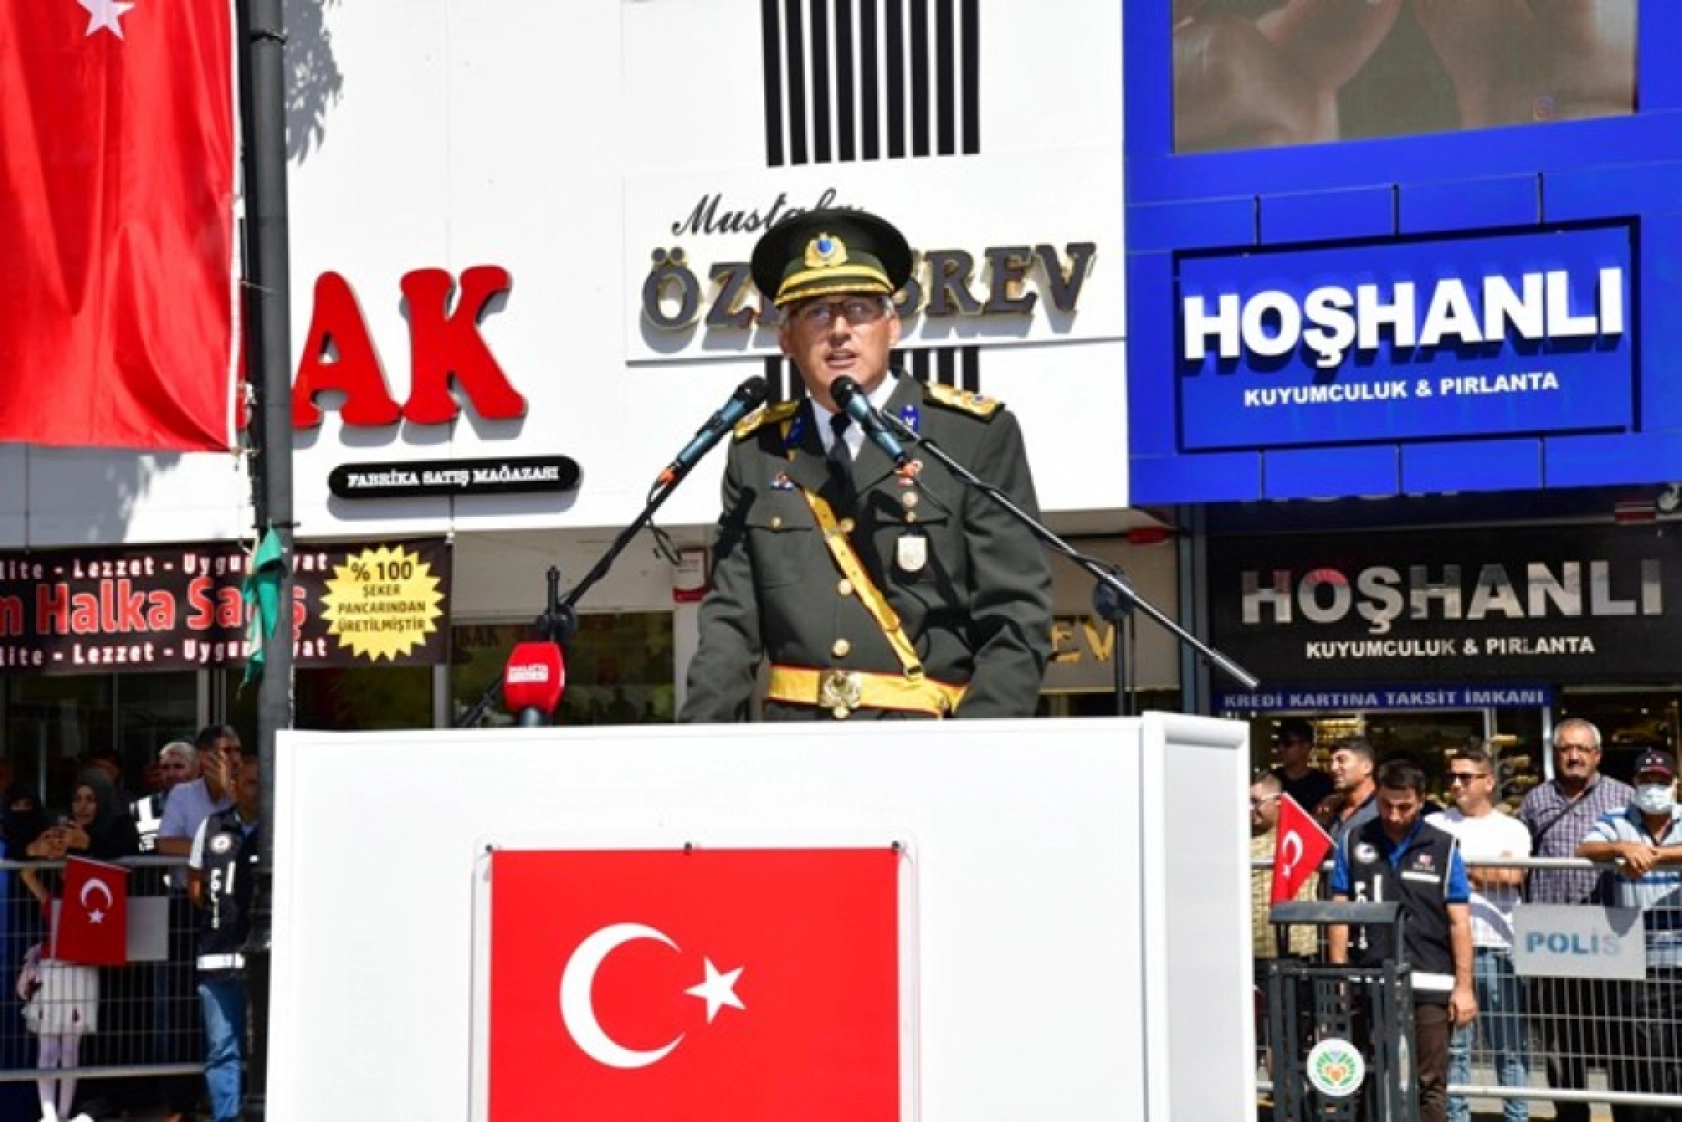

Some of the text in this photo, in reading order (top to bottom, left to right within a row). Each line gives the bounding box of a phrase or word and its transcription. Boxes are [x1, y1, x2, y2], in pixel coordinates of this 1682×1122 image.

[671, 187, 866, 236] Must
[642, 241, 1096, 328] ÖZREV
[1184, 267, 1624, 368] HOŞHANLI
[291, 265, 526, 429] AK
[1244, 372, 1560, 407] KUYUMCULUK & PIRLANTA
[73, 557, 154, 578] Lezzet
[376, 561, 413, 580] 100
[36, 578, 175, 635] Halka
[338, 601, 426, 614] PANCARINDAN
[1241, 560, 1662, 634] HOŞHANLI
[73, 642, 154, 664] Lezzet
[1306, 636, 1595, 658] KUYUMCULUK & PIRLANTA
[1224, 687, 1544, 708] KREDİ KARTINA TAKSİT İMKANI
[1526, 926, 1621, 955] POLİS
